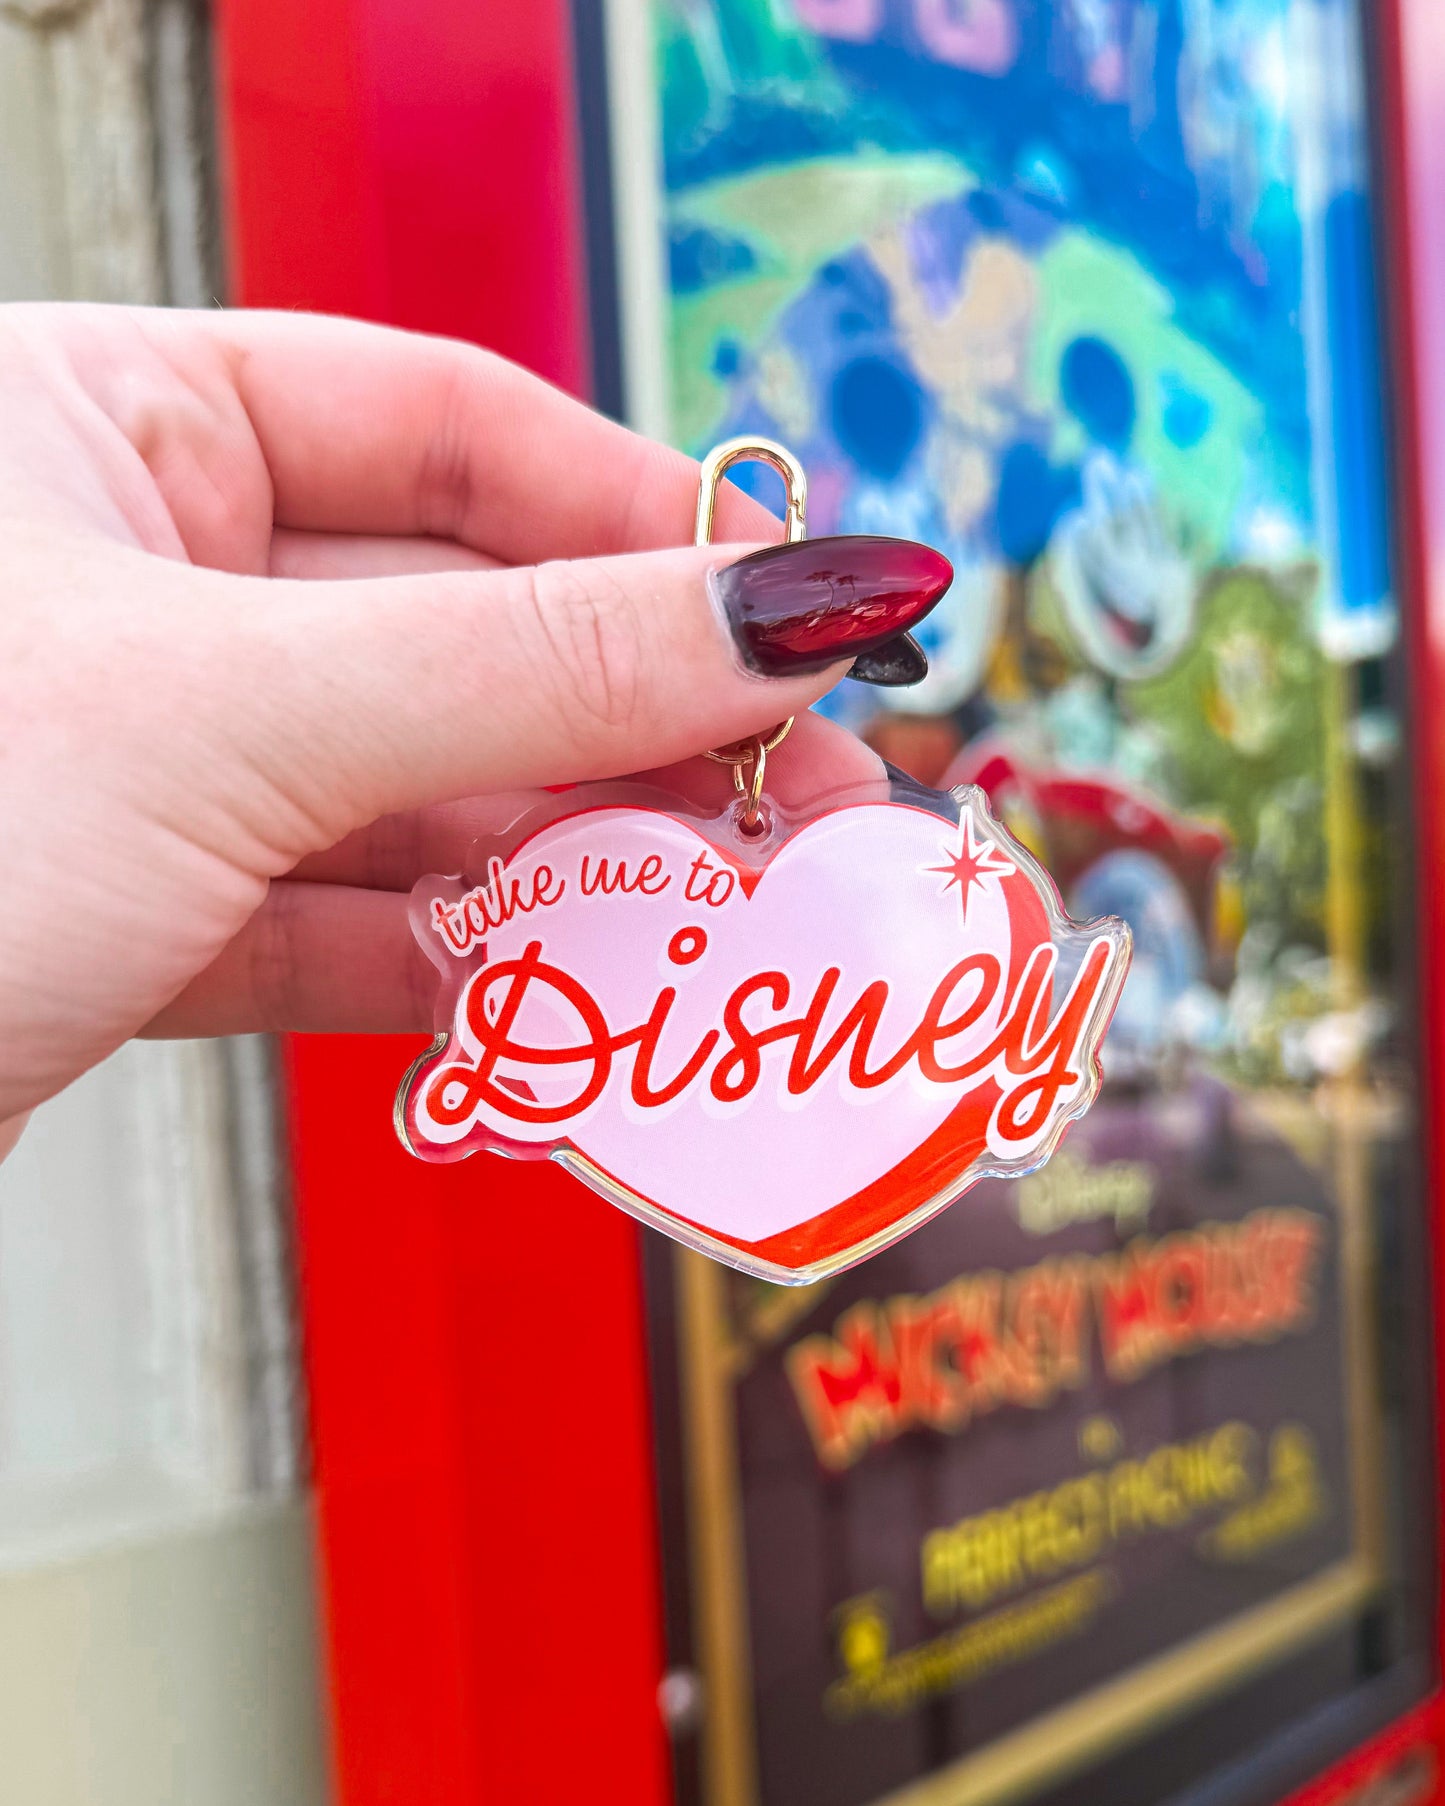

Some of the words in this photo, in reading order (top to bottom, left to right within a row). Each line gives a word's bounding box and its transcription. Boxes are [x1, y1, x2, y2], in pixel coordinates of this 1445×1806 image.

[435, 856, 566, 950] take
[580, 854, 672, 896] me
[684, 849, 736, 907] to
[425, 925, 1111, 1140] Disney
